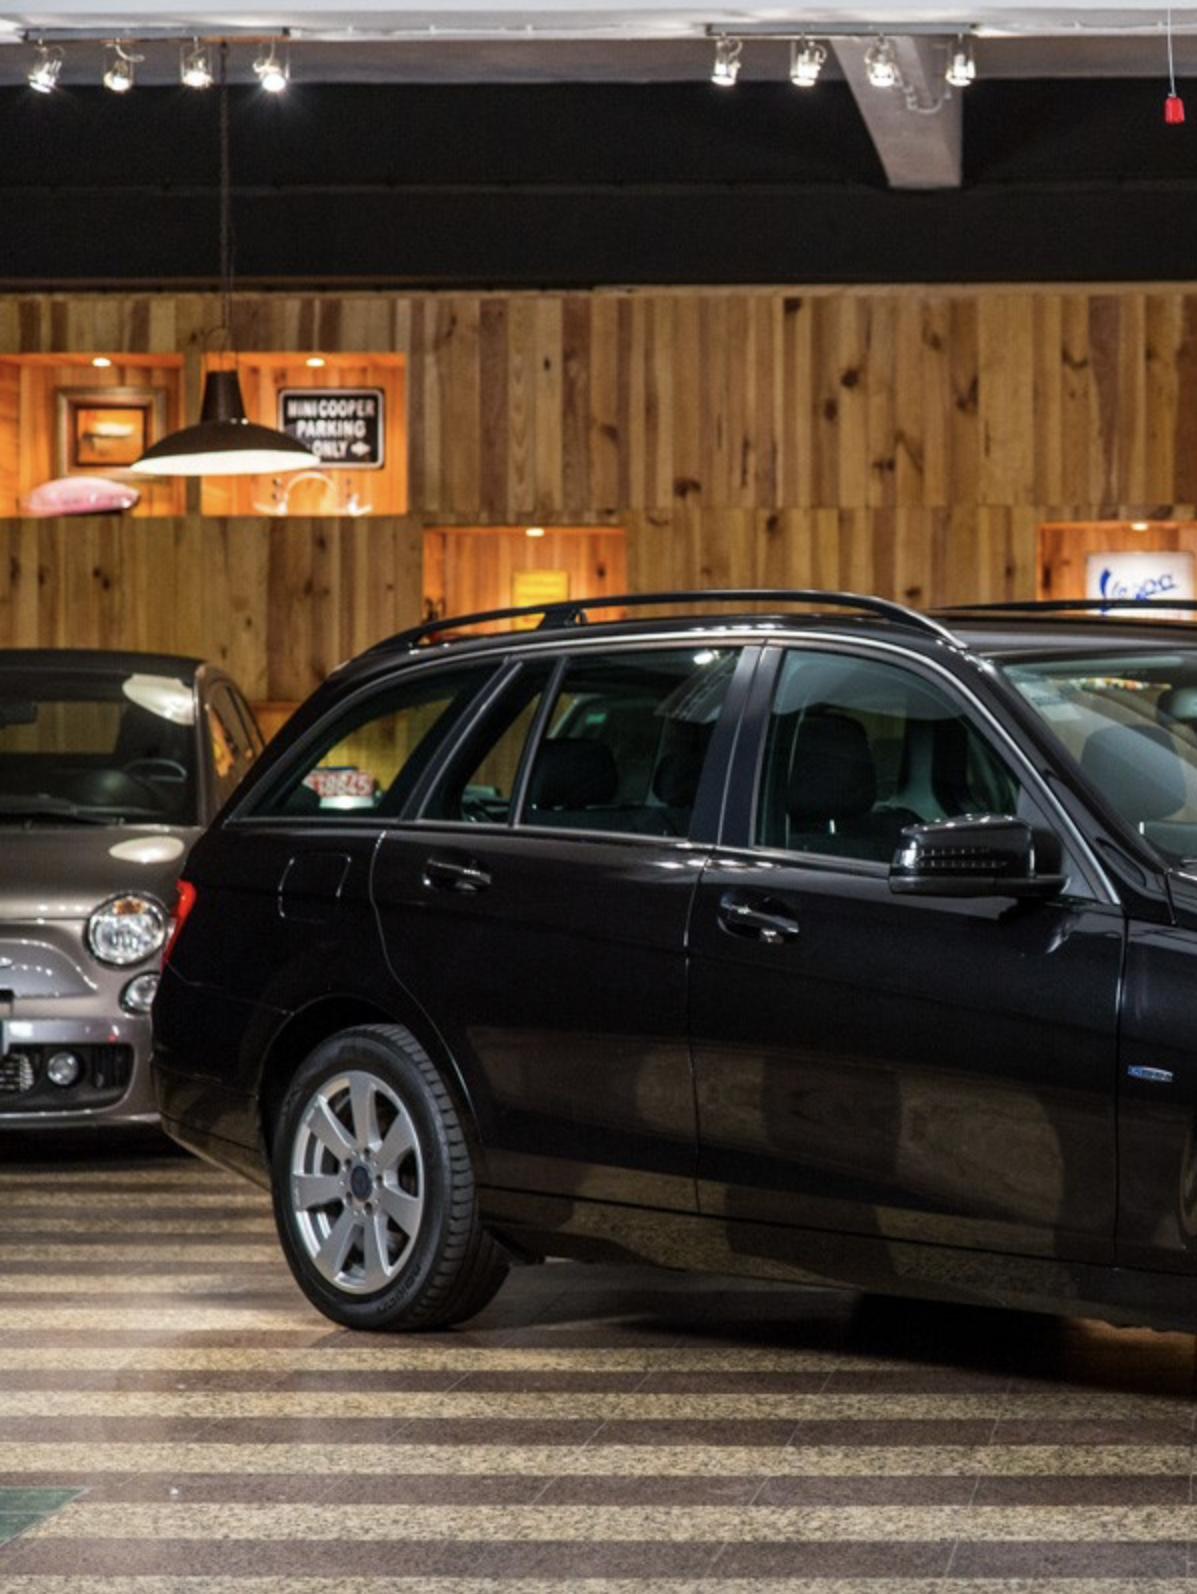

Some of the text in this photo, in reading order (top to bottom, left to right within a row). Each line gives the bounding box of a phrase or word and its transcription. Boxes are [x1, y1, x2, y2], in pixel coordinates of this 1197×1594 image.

[319, 400, 375, 418] COOPER
[296, 420, 366, 438] PARKING
[312, 440, 348, 458] ONLY
